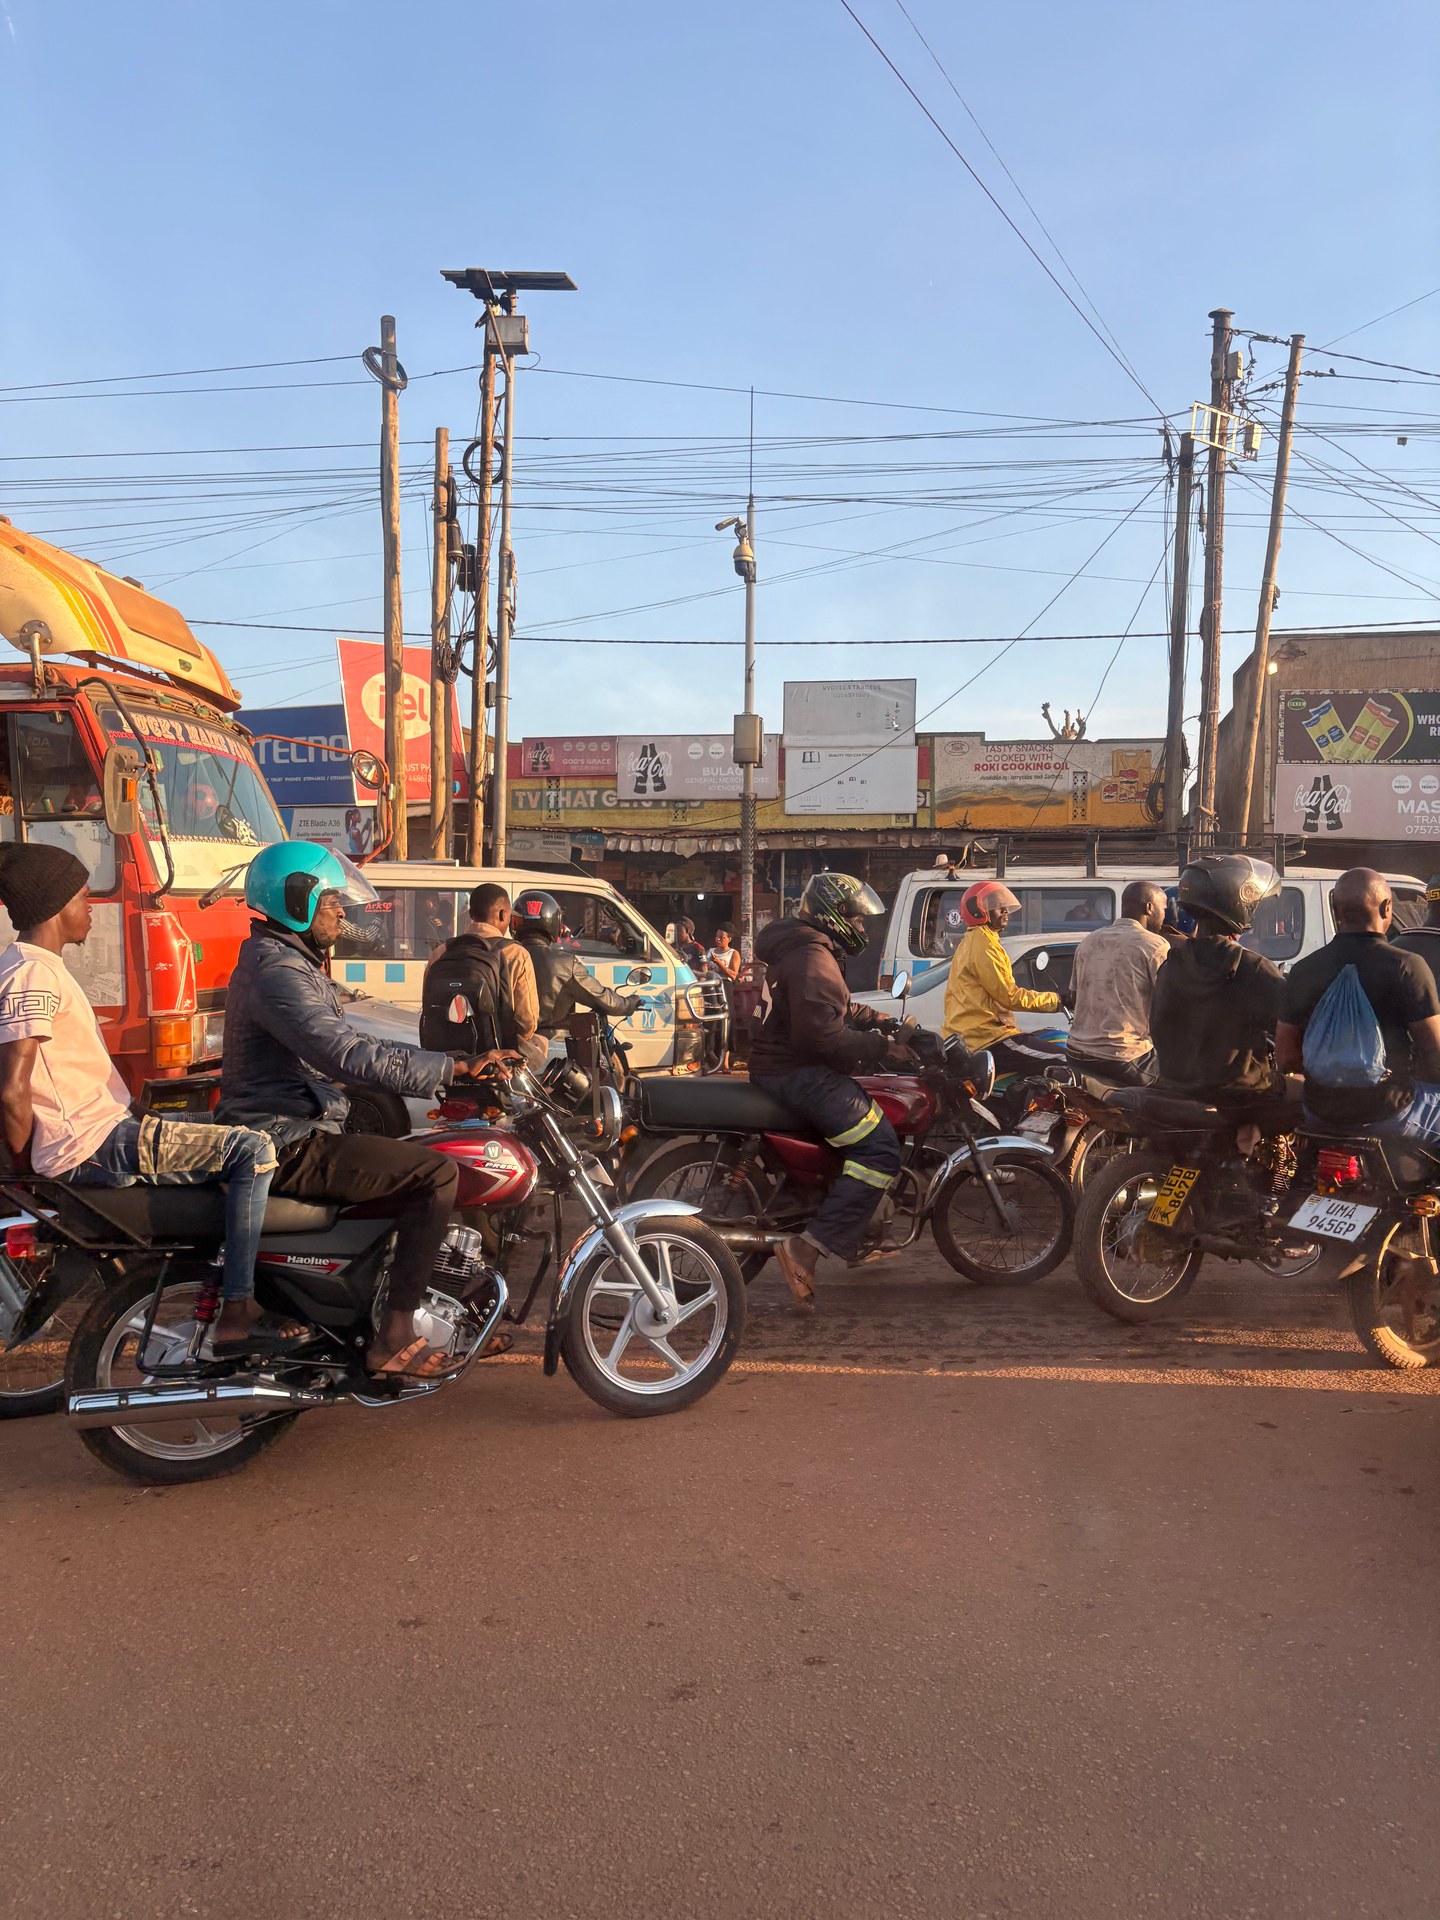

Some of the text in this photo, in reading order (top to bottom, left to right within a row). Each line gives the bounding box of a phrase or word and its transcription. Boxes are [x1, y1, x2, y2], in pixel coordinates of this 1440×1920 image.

[379, 685, 428, 721] iel
[117, 710, 185, 741] LUCKY
[255, 735, 349, 764] TECNO
[985, 744, 1054, 753] TASTY SNACKS
[985, 753, 1053, 762] COOKED WITH
[702, 767, 744, 776] BULAG
[974, 761, 1070, 772] ROKI COOKING OIL
[515, 791, 542, 808] TV
[546, 790, 598, 808] THAT
[1294, 784, 1352, 814] Coca-Cola
[299, 819, 309, 827] ZTE
[310, 819, 327, 827] Blade
[1414, 815, 1440, 824] TRA
[1160, 1168, 1184, 1197] UED
[1169, 1170, 1197, 1209] 867B
[1325, 1202, 1358, 1219] UMA
[1306, 1215, 1356, 1236] 945GP
